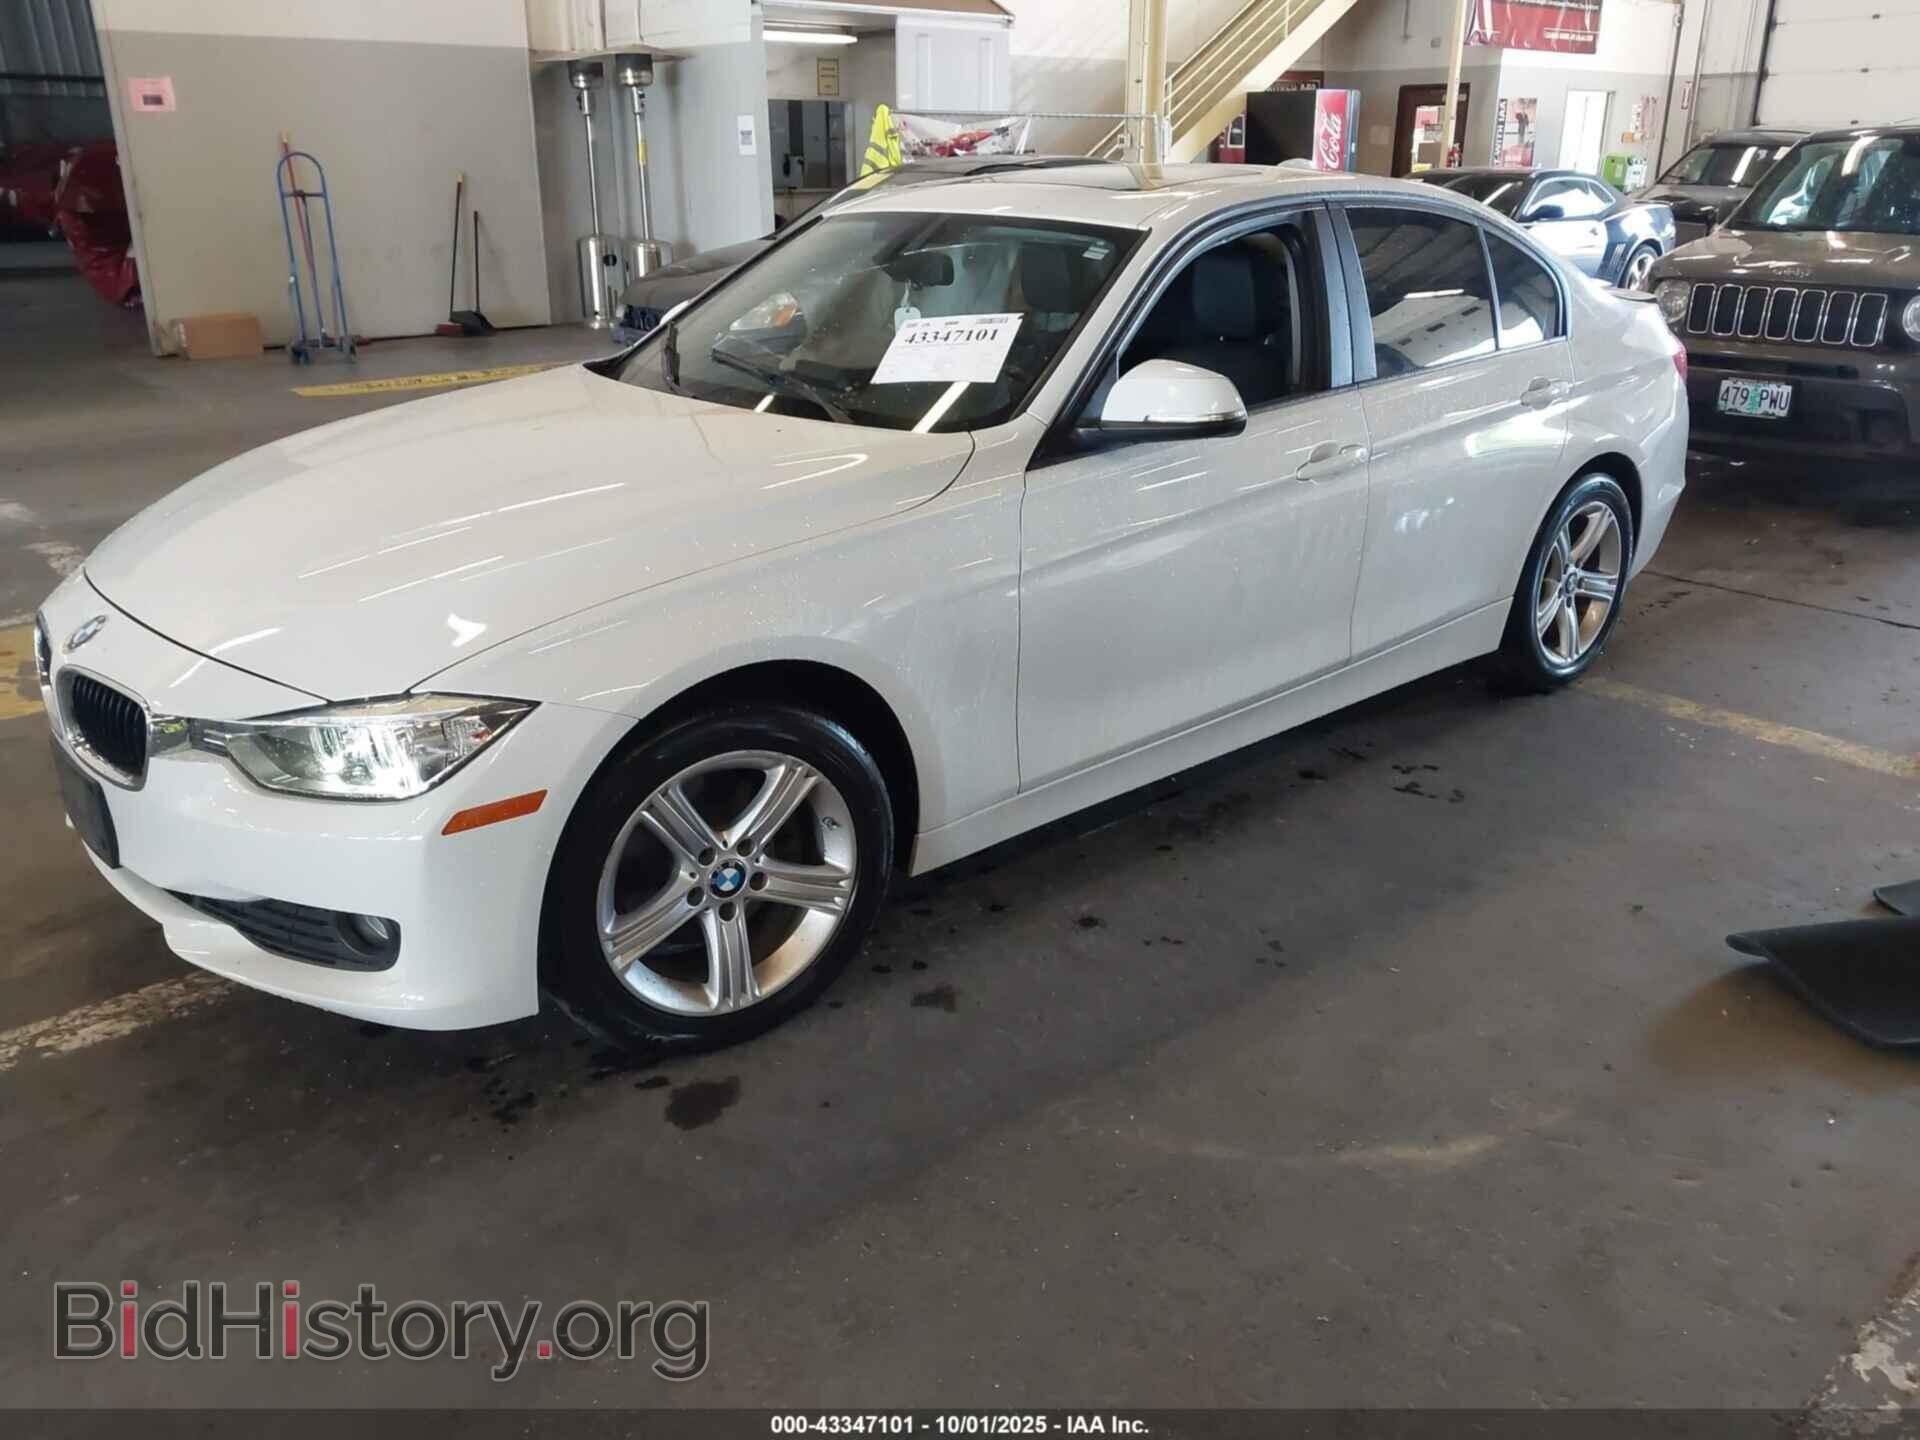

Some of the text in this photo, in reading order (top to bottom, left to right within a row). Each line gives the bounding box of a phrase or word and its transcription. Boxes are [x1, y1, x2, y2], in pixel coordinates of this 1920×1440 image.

[1319, 110, 1343, 169] Cola
[905, 328, 999, 345] 43347101
[1720, 386, 1790, 411] 479 PWU
